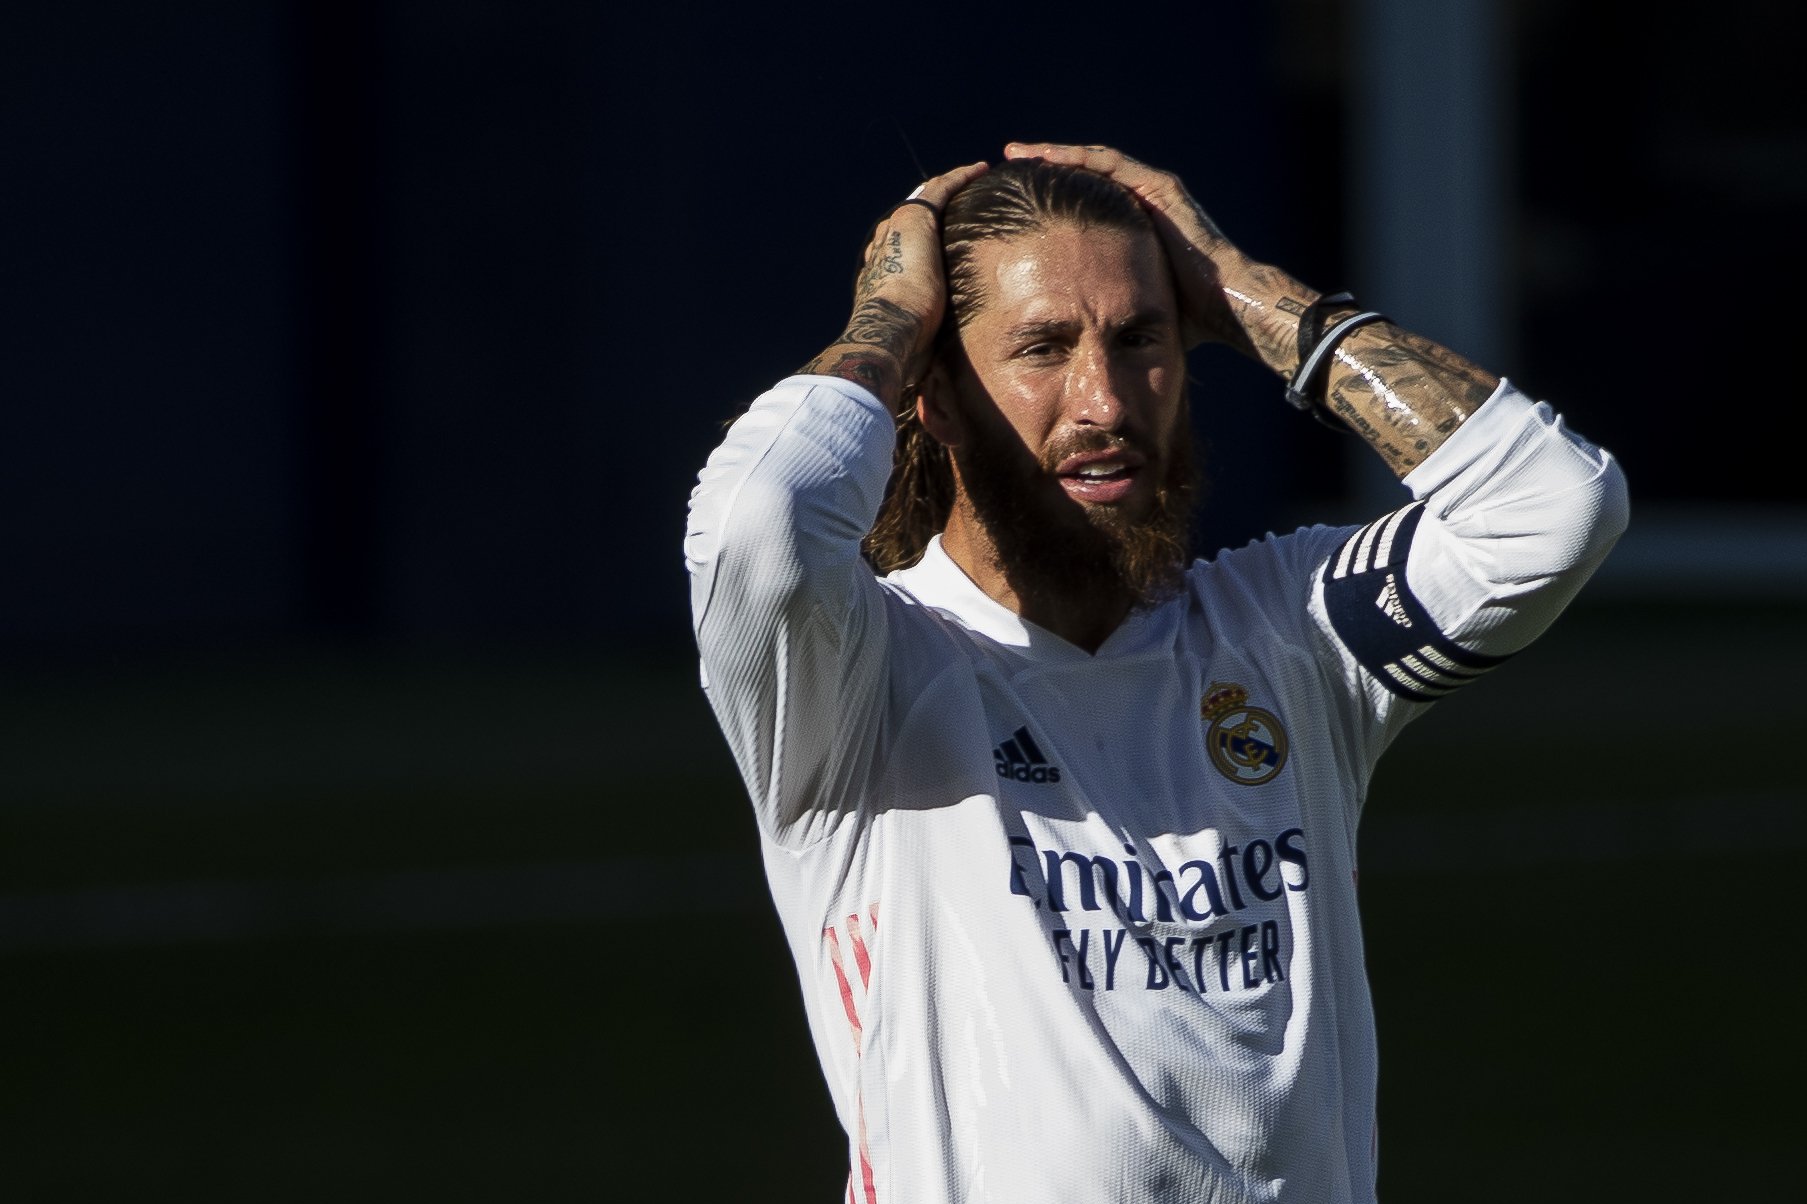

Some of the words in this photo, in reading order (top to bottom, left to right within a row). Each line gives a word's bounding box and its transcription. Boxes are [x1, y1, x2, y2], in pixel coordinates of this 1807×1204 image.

[995, 760, 1061, 783] didas
[1009, 828, 1309, 922] Emirates
[1053, 929, 1126, 991] FLY
[1138, 919, 1285, 993] BETTER
